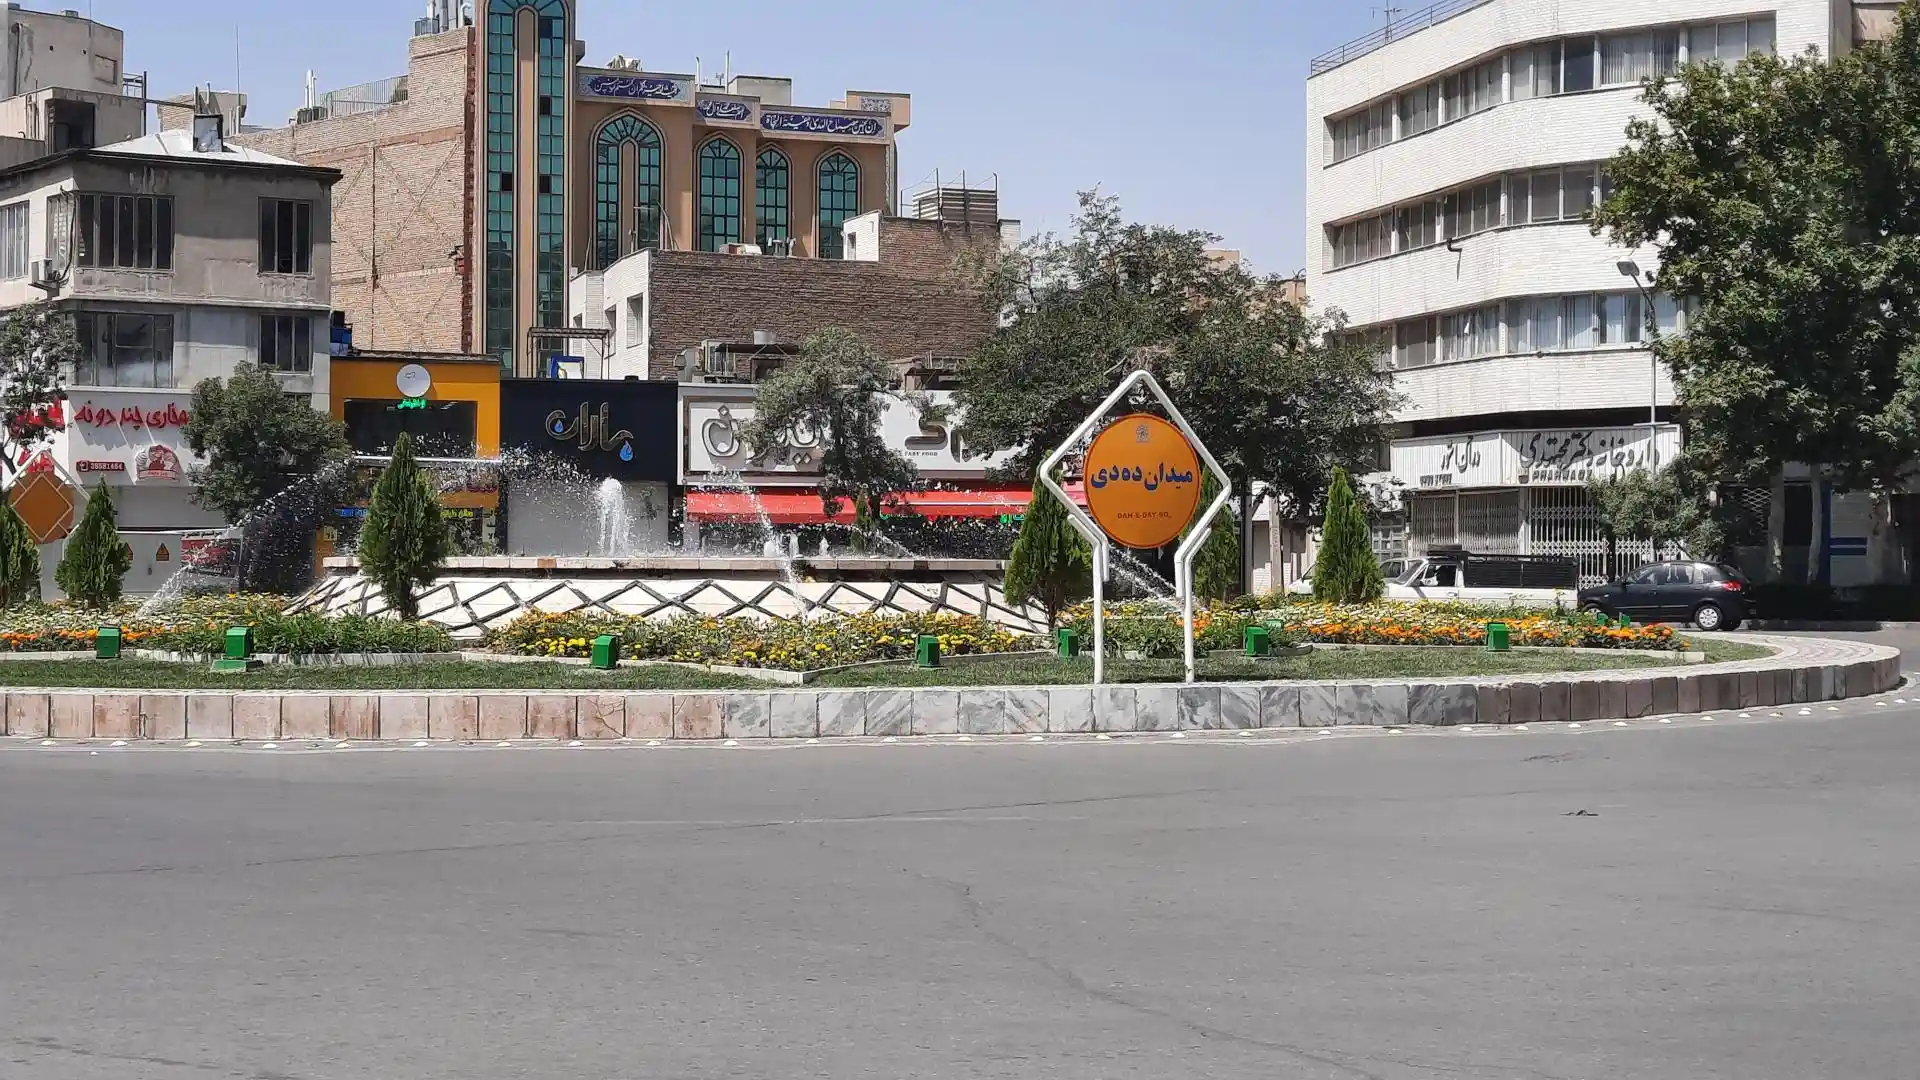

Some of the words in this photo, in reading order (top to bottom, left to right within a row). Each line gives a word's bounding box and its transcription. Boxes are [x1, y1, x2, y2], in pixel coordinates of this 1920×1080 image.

[1091, 464, 1119, 488] دی
[1121, 465, 1143, 481] ده
[1144, 461, 1193, 491] میدان
